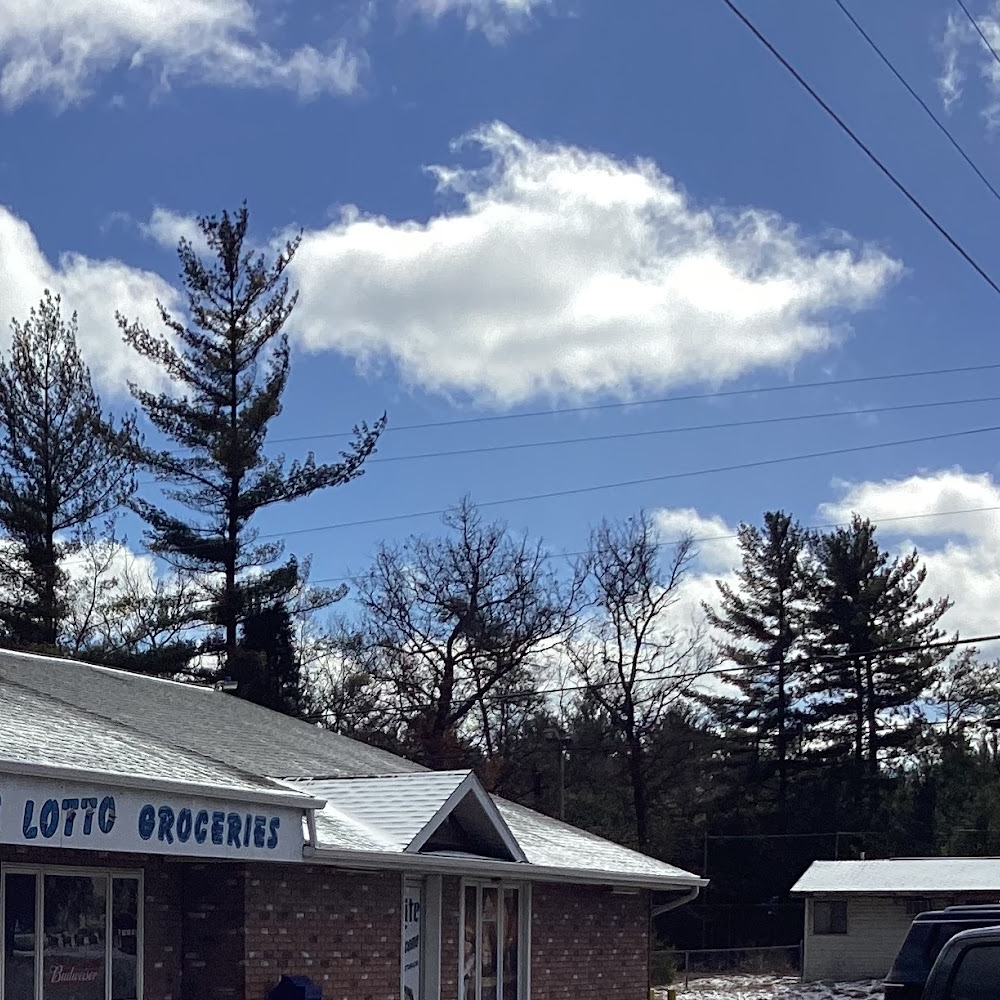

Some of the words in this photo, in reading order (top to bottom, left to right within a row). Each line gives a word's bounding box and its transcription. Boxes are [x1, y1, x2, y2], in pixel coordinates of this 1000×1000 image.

[22, 796, 117, 839] LOTTO
[138, 804, 281, 849] GROCERIES
[49, 964, 98, 984] Budweiser
